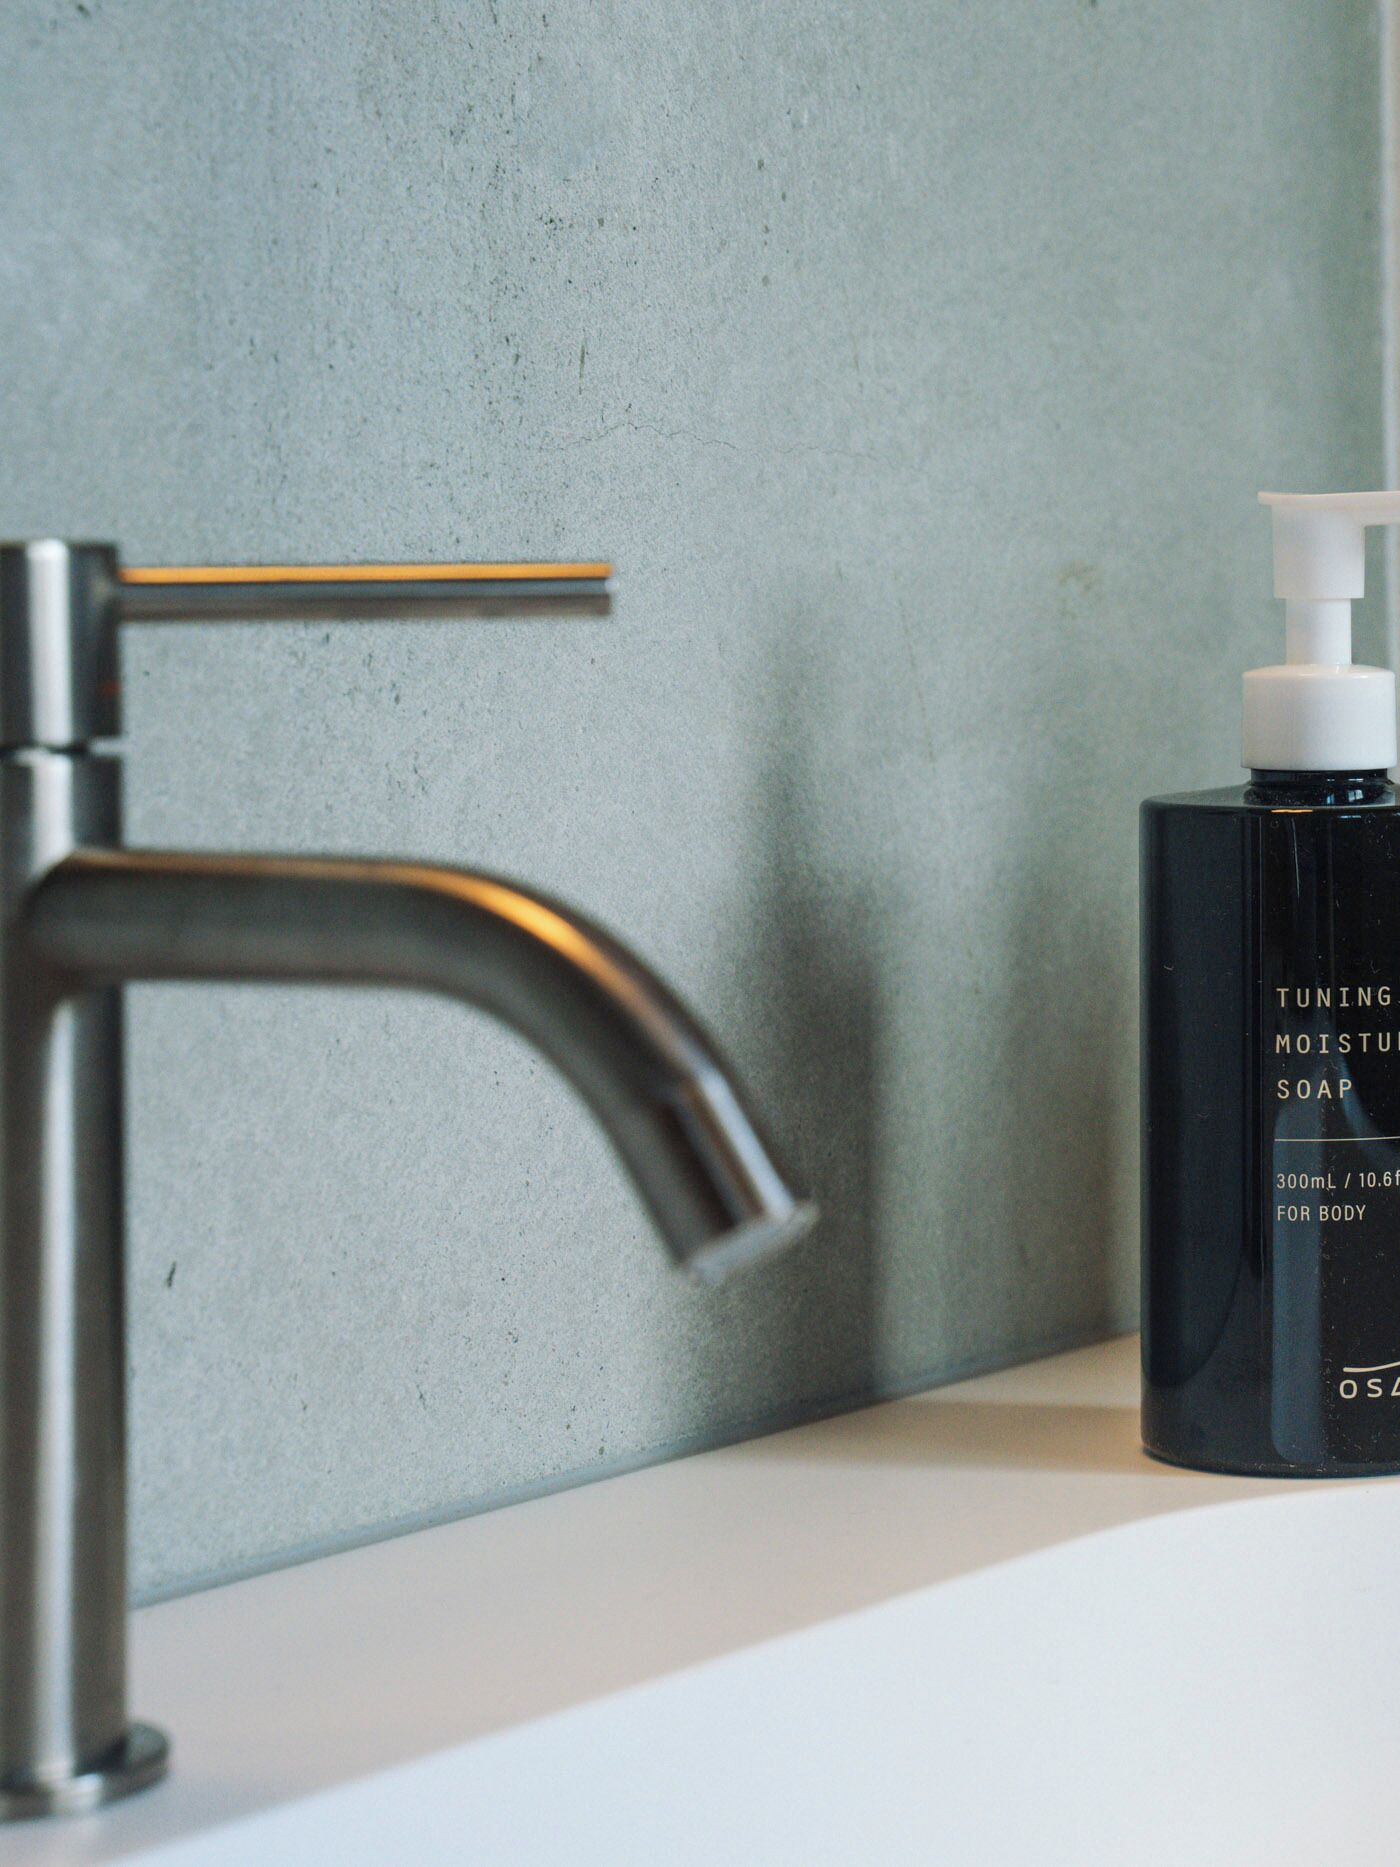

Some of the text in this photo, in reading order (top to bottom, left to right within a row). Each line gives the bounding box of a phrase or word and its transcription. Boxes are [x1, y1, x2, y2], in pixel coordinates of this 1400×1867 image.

[1275, 985, 1393, 1009] TUNING
[1276, 1078, 1354, 1100] SOAP
[1275, 1172, 1337, 1190] 300mL
[1344, 1172, 1352, 1189] /
[1276, 1204, 1367, 1222] FOR BODY
